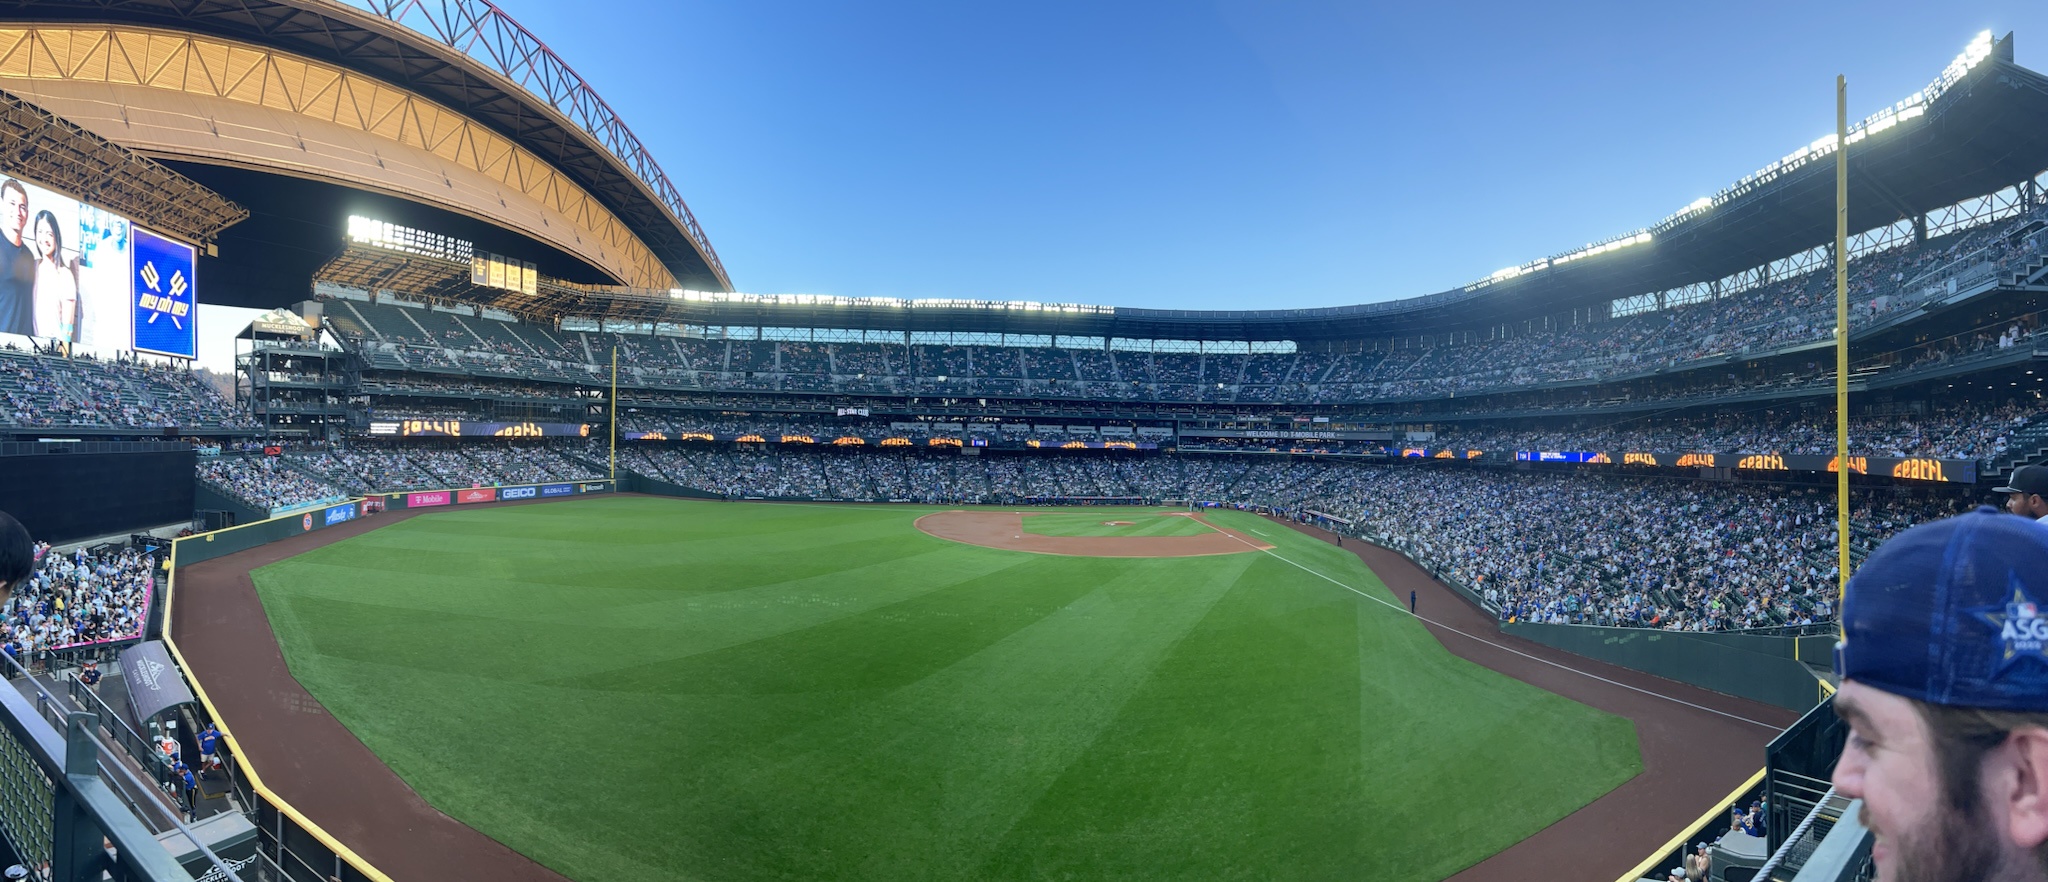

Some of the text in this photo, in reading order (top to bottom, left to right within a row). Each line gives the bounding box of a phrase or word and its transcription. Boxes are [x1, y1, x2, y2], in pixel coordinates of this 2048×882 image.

[139, 293, 189, 317] my oh my
[1246, 430, 1278, 438] WELCOME
[1291, 431, 1318, 439] T-MOBILE
[422, 494, 443, 504] Mobile
[503, 487, 536, 499] GEICO
[2001, 618, 2048, 640] ASG
